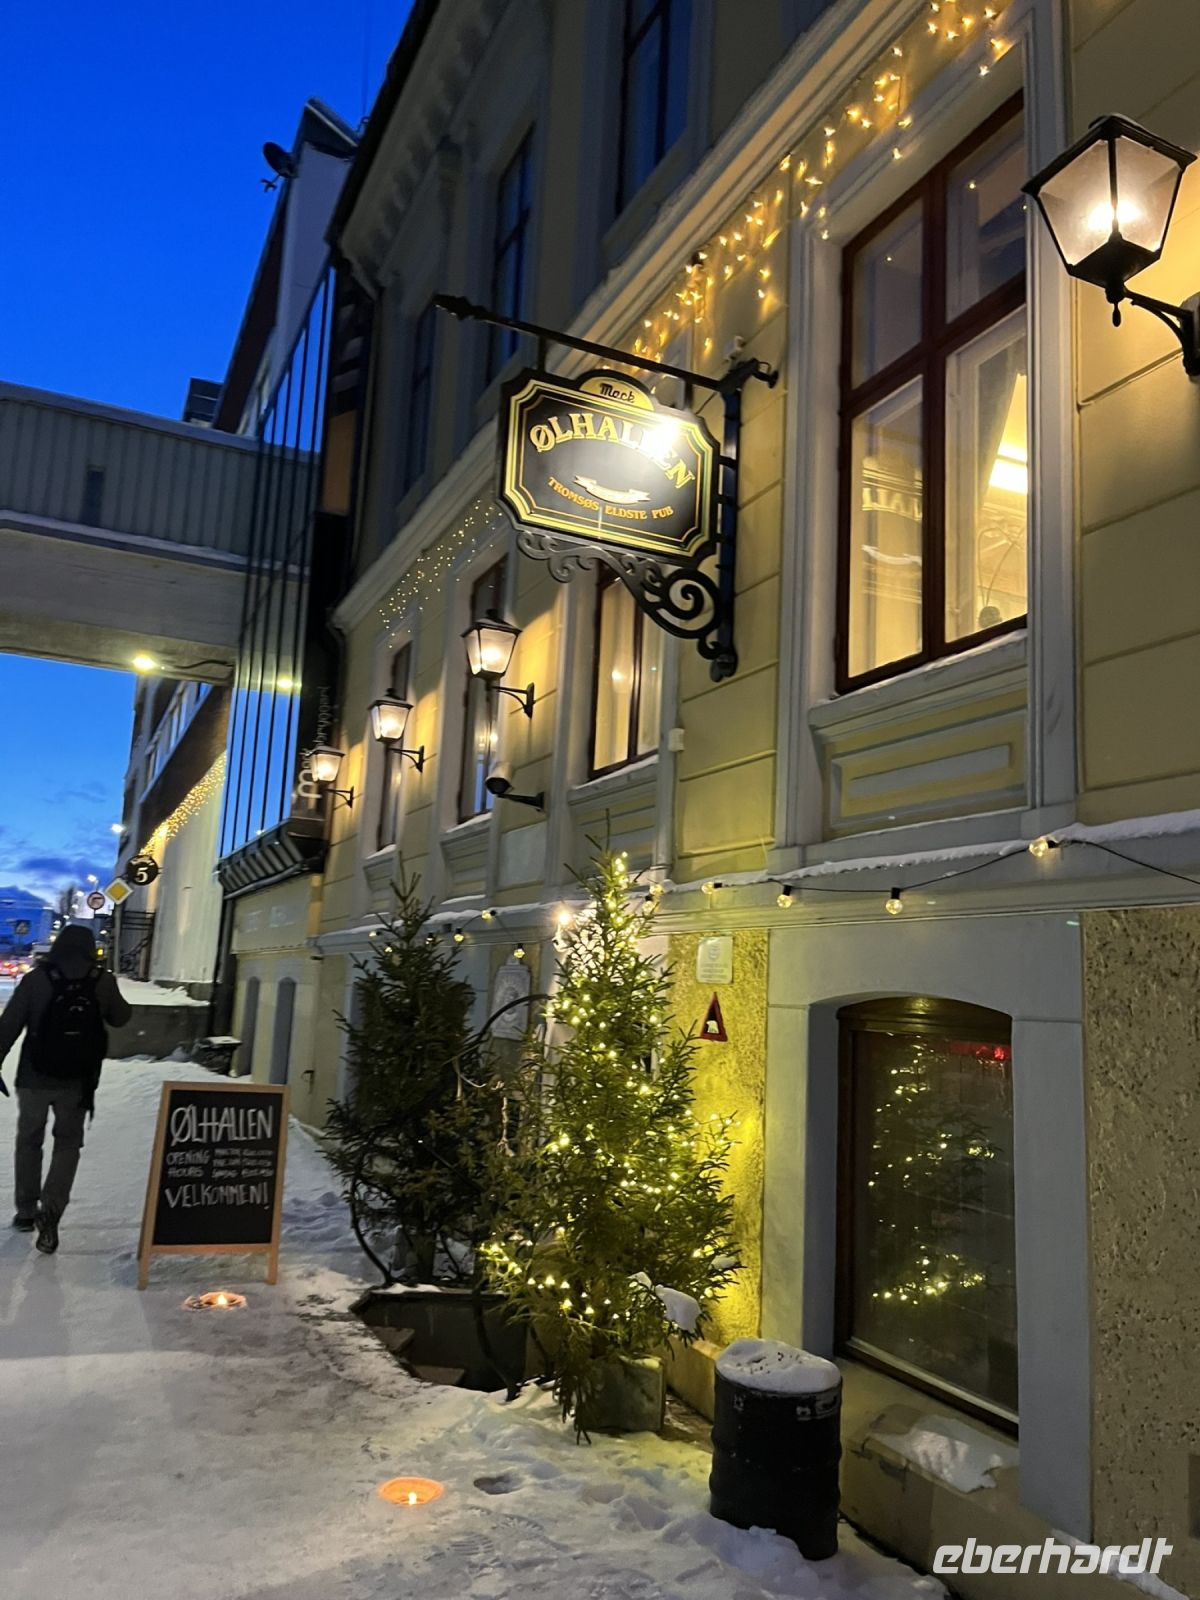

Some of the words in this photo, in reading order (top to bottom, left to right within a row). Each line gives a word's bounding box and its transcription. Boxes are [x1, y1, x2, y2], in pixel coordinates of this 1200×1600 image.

[599, 382, 636, 403] Mack
[547, 476, 600, 511] TROMSØS
[604, 504, 648, 519] ELDSTE
[651, 505, 674, 519] PUB
[134, 866, 149, 883] 5
[170, 1104, 273, 1146] ØLHALLEN
[166, 1150, 211, 1165] OPENING
[165, 1181, 270, 1210] VELKOMMEN!
